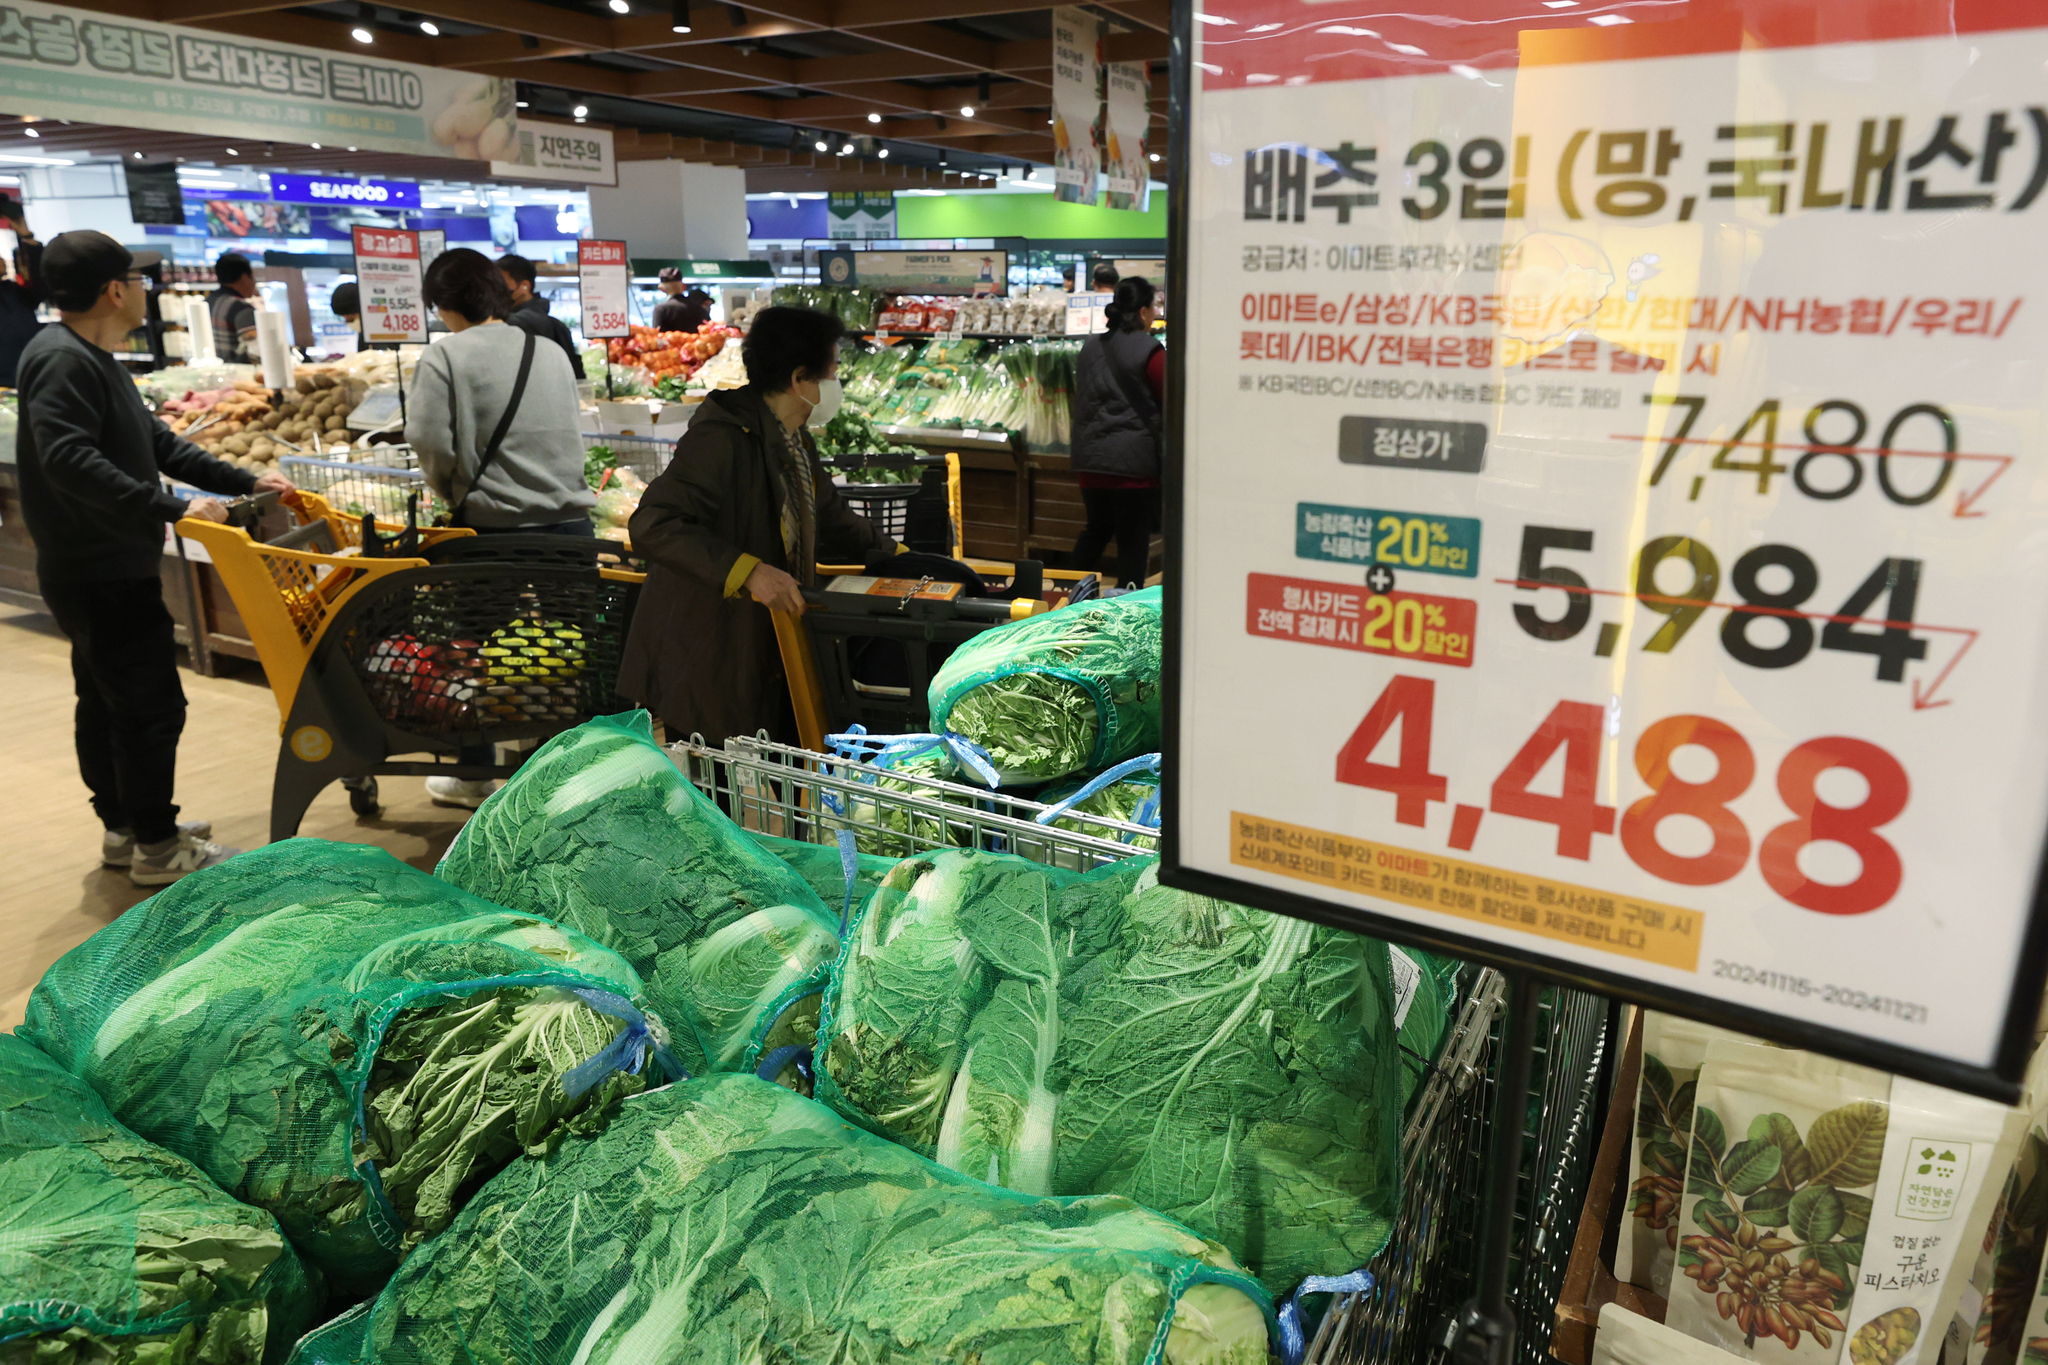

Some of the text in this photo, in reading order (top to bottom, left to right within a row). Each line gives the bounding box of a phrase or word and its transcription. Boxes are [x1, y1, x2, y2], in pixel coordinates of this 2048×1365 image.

[1243, 105, 2048, 224] 배추 3입 (망,국내산)
[309, 181, 388, 202] SEAFOOD
[582, 246, 622, 261] 카드행사
[1241, 244, 1308, 272] 공급처
[382, 314, 420, 332] 4,188
[592, 312, 627, 332] 3,584
[1240, 331, 1721, 376] 롯데/IBK/전북은행 카드로 결제 시
[1373, 427, 1453, 460] 정상가
[1642, 395, 1958, 507] 7,480
[1305, 511, 1374, 539] 농림축산
[1321, 535, 1372, 560] 식품부
[1428, 544, 1469, 570] 할인
[1282, 585, 1360, 618] 행사카드
[1512, 524, 1928, 683] 5,984
[1257, 608, 1294, 635] 전액
[1423, 629, 1469, 659] 할인
[1334, 673, 1911, 917] 4,488
[1239, 819, 1693, 936] 농림축산식품부와 이마트가 함께하는 행사상품 구매 시
[1239, 841, 1647, 950] 신세계포인트 카드 회원에 한해 할인을 제공합니다
[1908, 1182, 1955, 1199] 자연담은
[1892, 1235, 1942, 1250] 껍질 없는
[1897, 1253, 1928, 1274] 구운
[1863, 1267, 1940, 1292] 피스타치오
